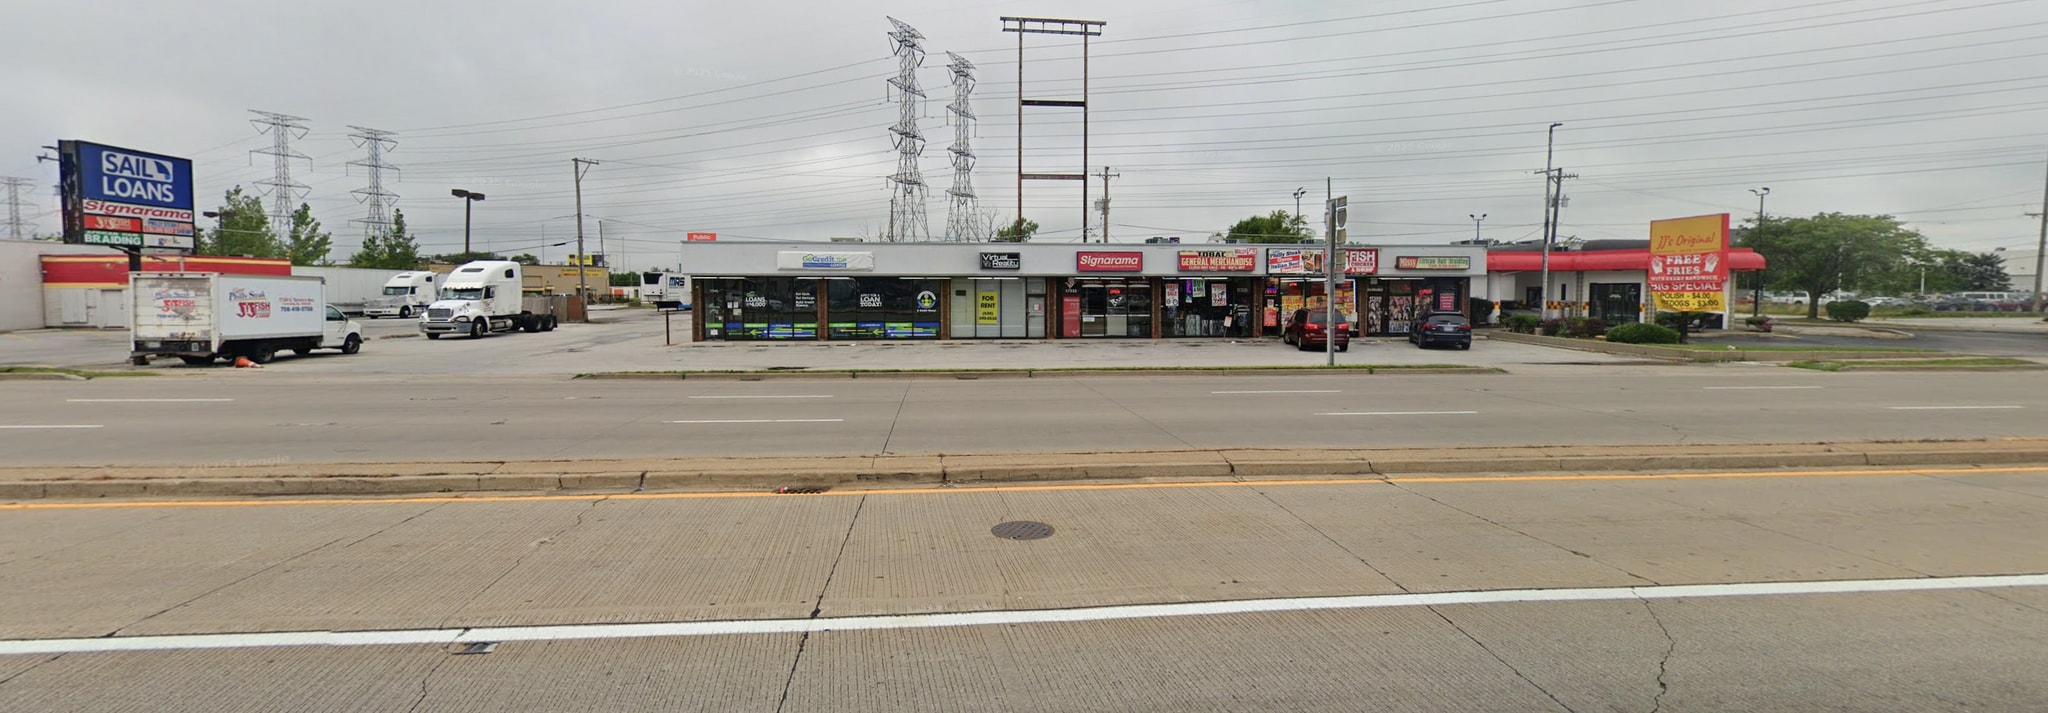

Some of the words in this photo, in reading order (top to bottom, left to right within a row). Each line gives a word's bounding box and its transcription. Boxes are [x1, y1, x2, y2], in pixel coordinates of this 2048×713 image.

[105, 153, 154, 178] SAIL
[103, 176, 174, 202] LOANS
[84, 200, 192, 219] Signarama
[84, 234, 141, 245] BRAIDING
[1676, 232, 1716, 247] Original
[1080, 255, 1139, 266] Signarama
[1181, 258, 1208, 266] GENERAL
[1210, 258, 1253, 266] MERCHANDISE
[1349, 251, 1375, 262] FISH
[1666, 254, 1702, 265] FREE
[1666, 266, 1700, 275] FRIES
[1672, 282, 1720, 291] SPECIAL
[256, 302, 271, 310] FISH
